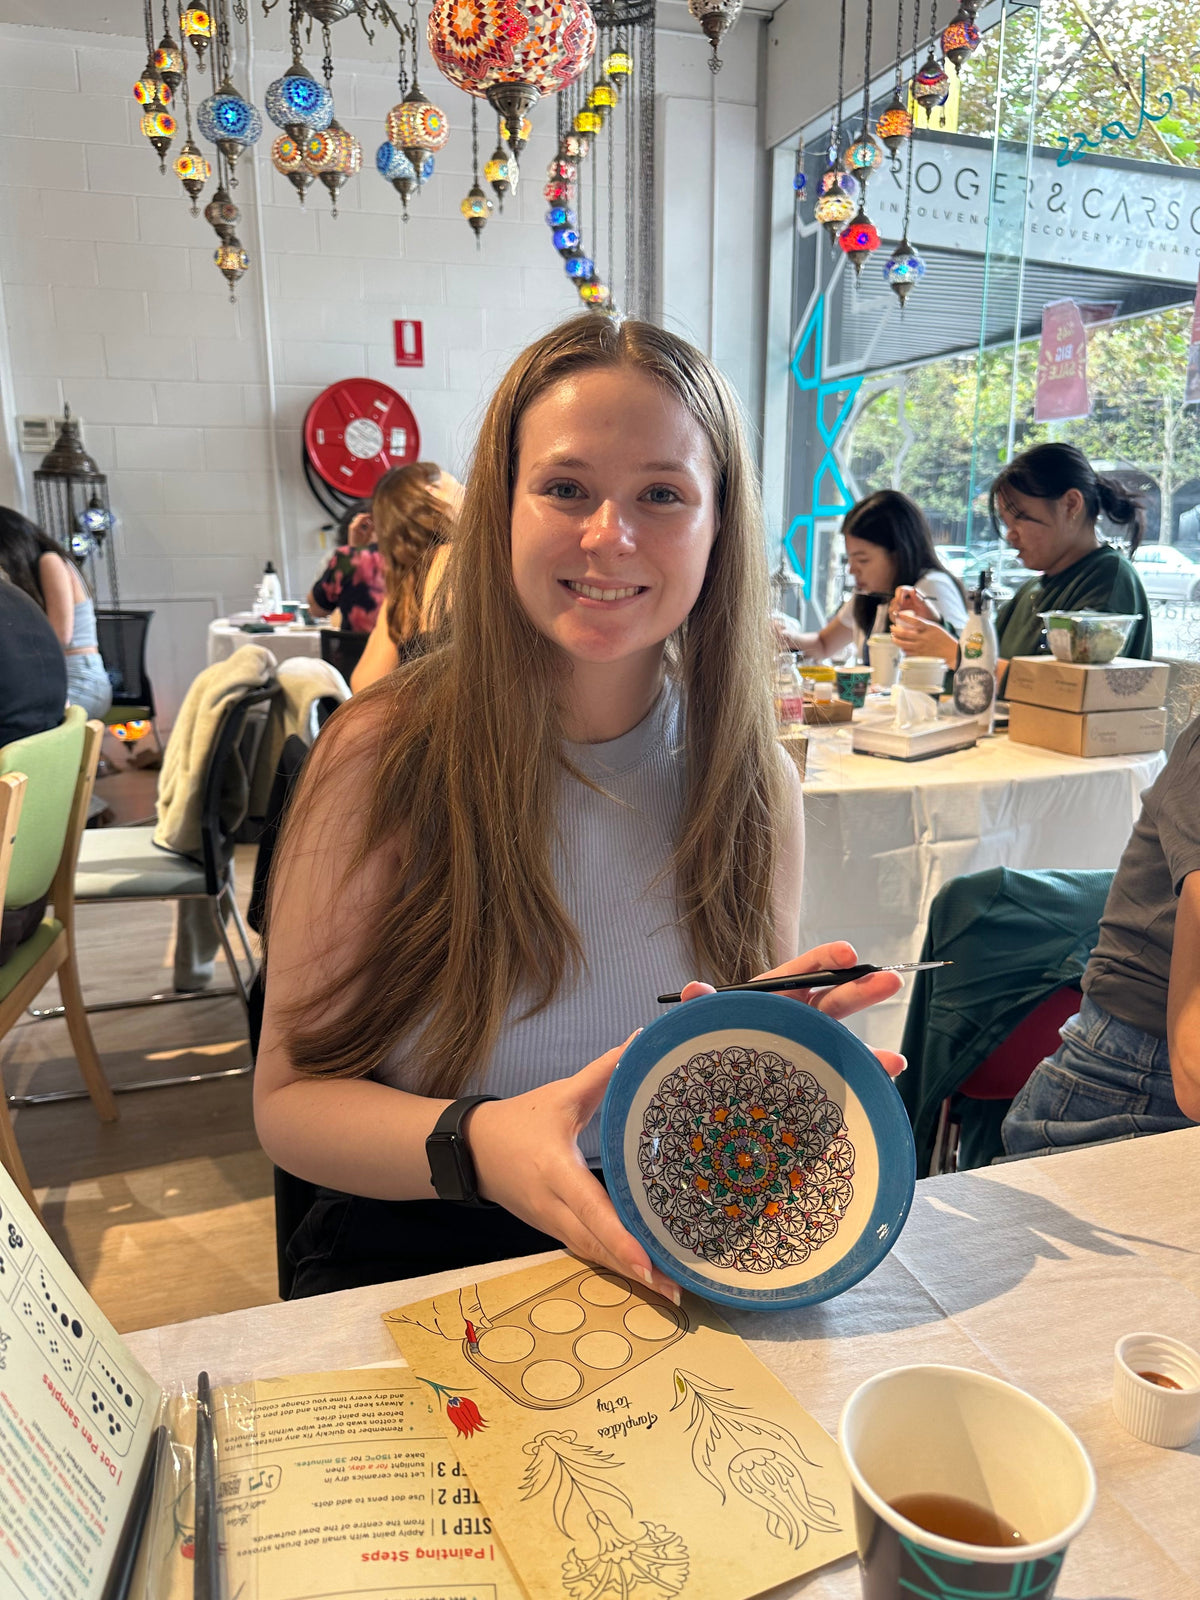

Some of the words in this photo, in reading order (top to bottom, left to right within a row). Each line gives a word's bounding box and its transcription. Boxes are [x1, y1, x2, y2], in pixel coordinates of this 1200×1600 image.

[41, 1372, 80, 1429] Samples
[281, 1400, 310, 1408] change
[596, 1398, 618, 1413] try
[615, 1396, 632, 1409] to
[313, 1405, 336, 1413] brush
[316, 1429, 345, 1437] quickly
[80, 1425, 99, 1454] Pen
[99, 1449, 117, 1477] Dot
[438, 1462, 446, 1477] 3
[336, 1498, 352, 1506] add
[367, 1495, 388, 1503] pens
[438, 1489, 446, 1505] 2
[453, 1488, 480, 1505] TEP
[299, 1527, 320, 1535] bowl
[442, 1520, 447, 1535] 1
[454, 1518, 492, 1535] STEP
[322, 1535, 346, 1544] small
[373, 1530, 395, 1539] paint
[275, 1541, 301, 1550] brush
[304, 1538, 319, 1546] dot
[361, 1550, 409, 1562] Steps
[416, 1547, 485, 1560] Painting
